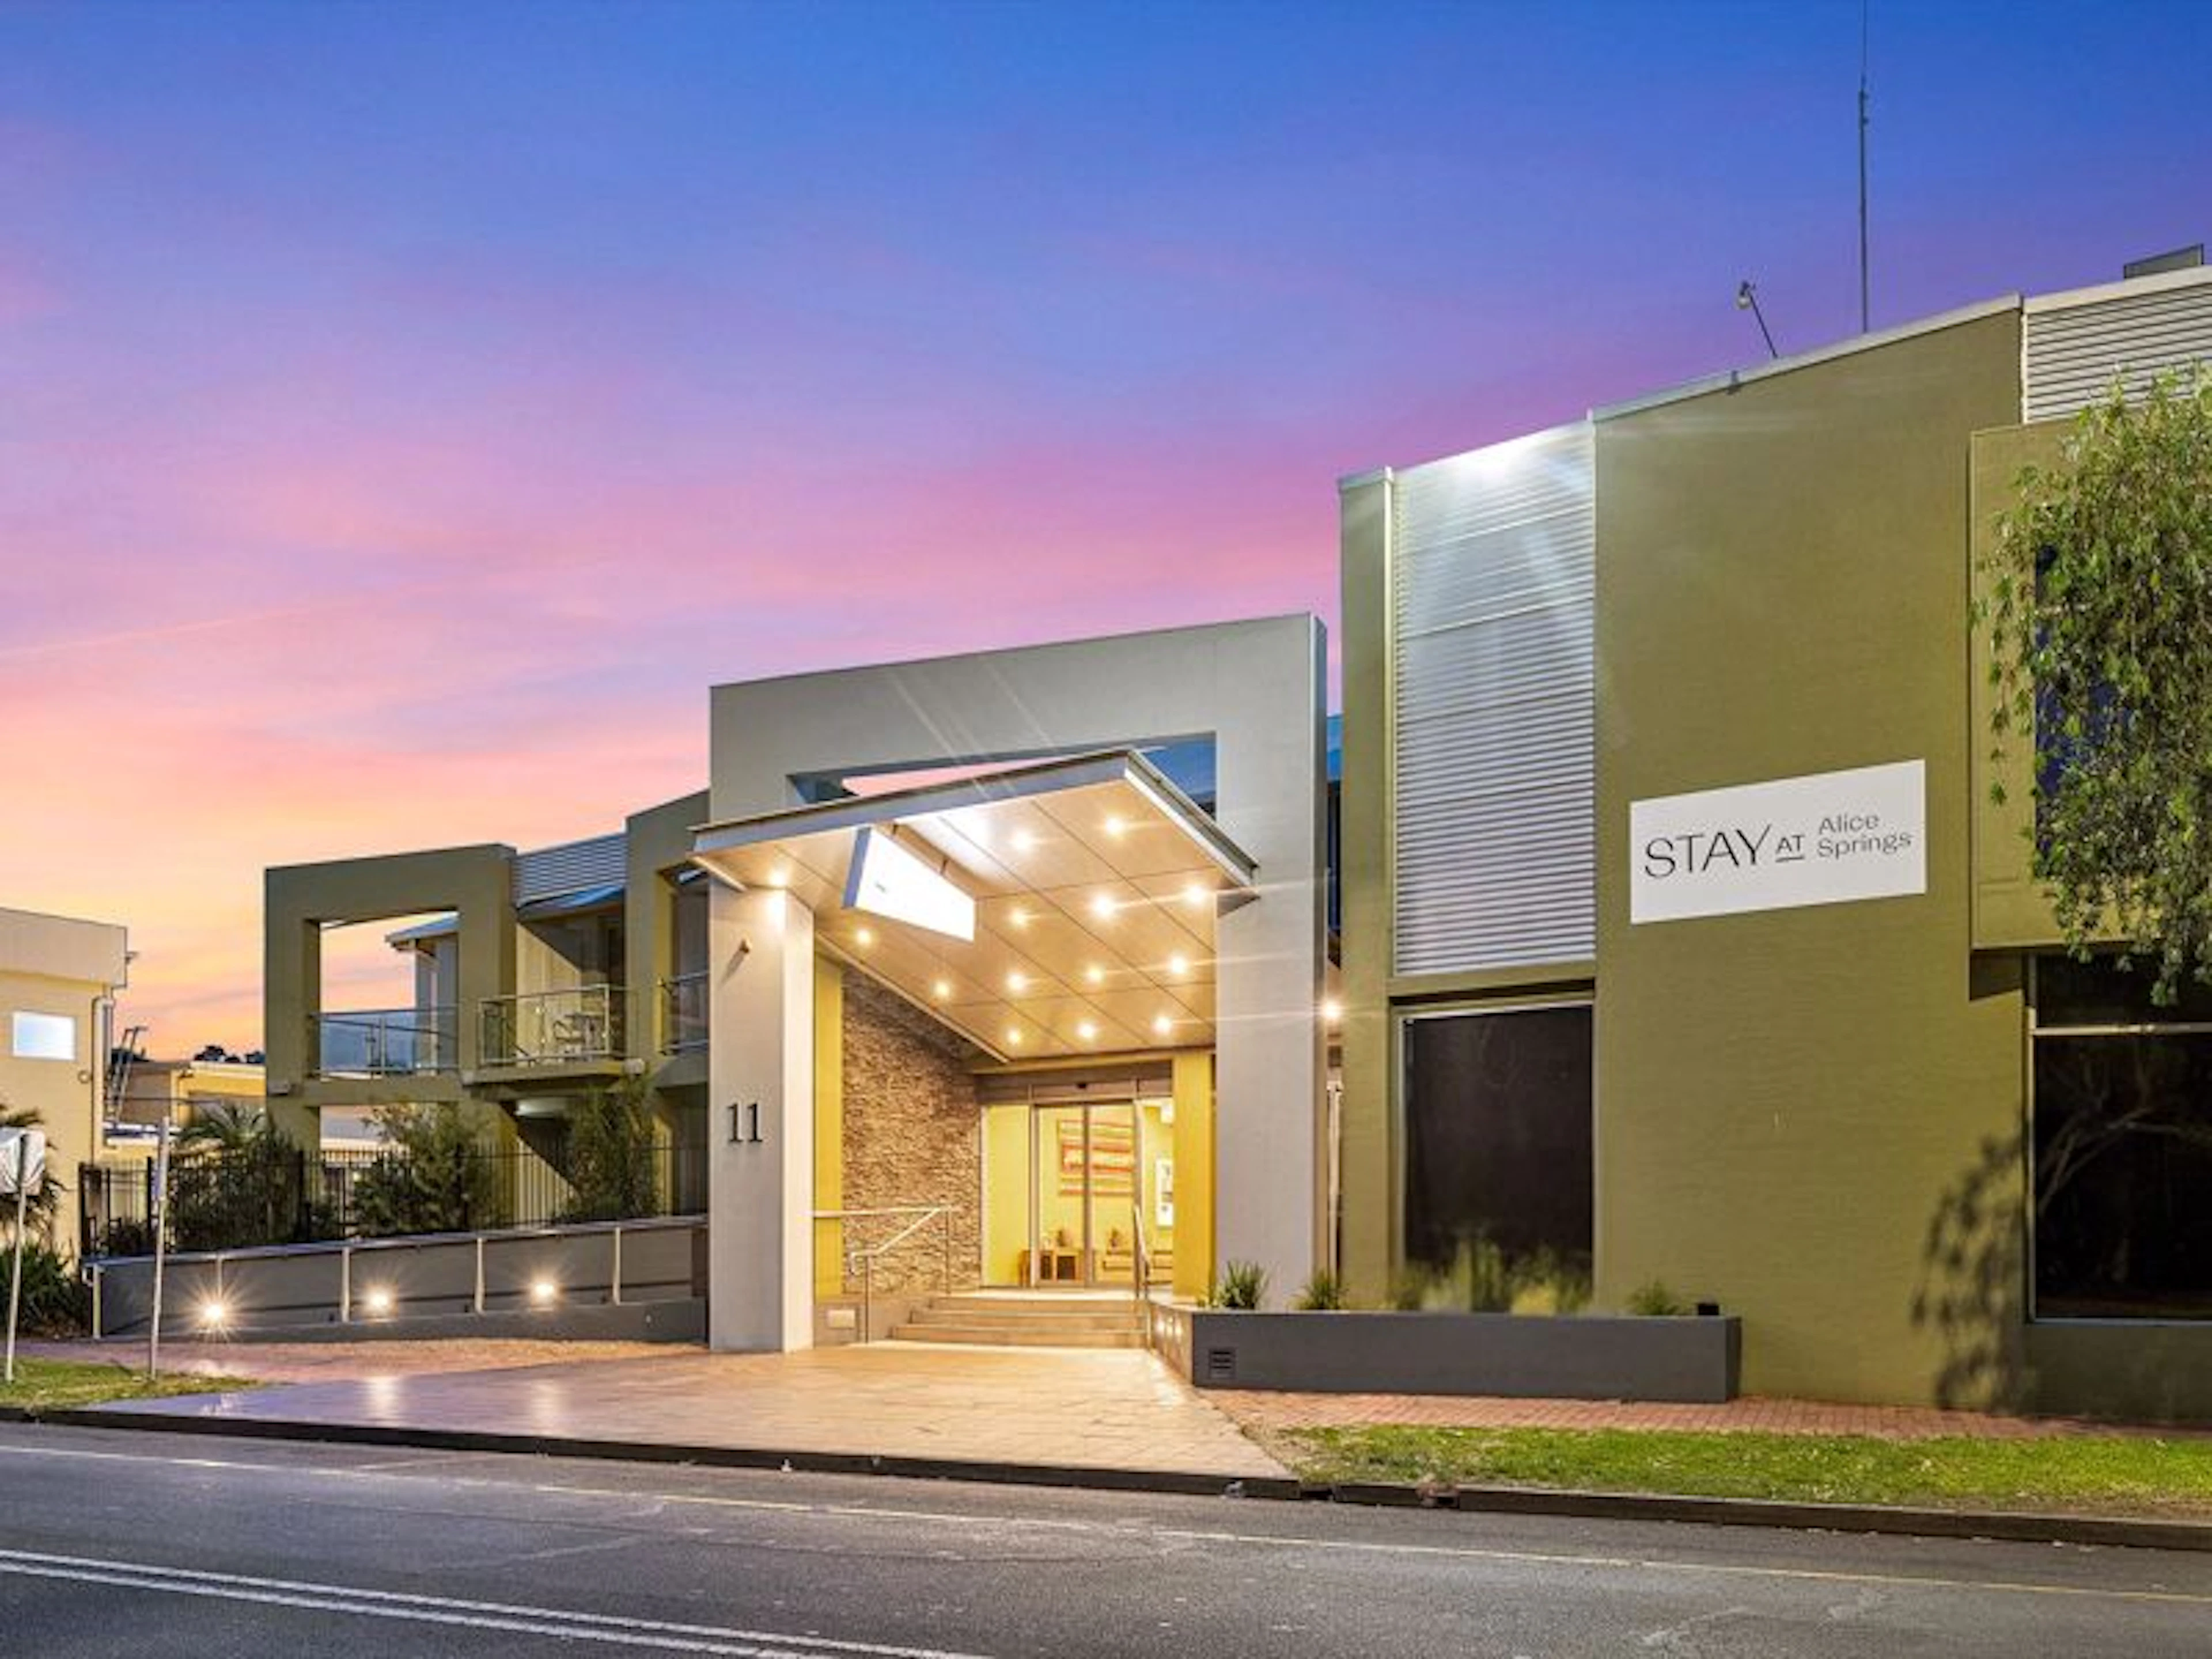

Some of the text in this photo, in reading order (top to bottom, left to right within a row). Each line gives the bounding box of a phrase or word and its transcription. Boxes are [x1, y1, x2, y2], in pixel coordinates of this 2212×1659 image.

[1818, 813, 1880, 834] Alice
[1645, 824, 1805, 878] STAY AT
[1817, 832, 1914, 859] Springs
[726, 1102, 763, 1143] 11
